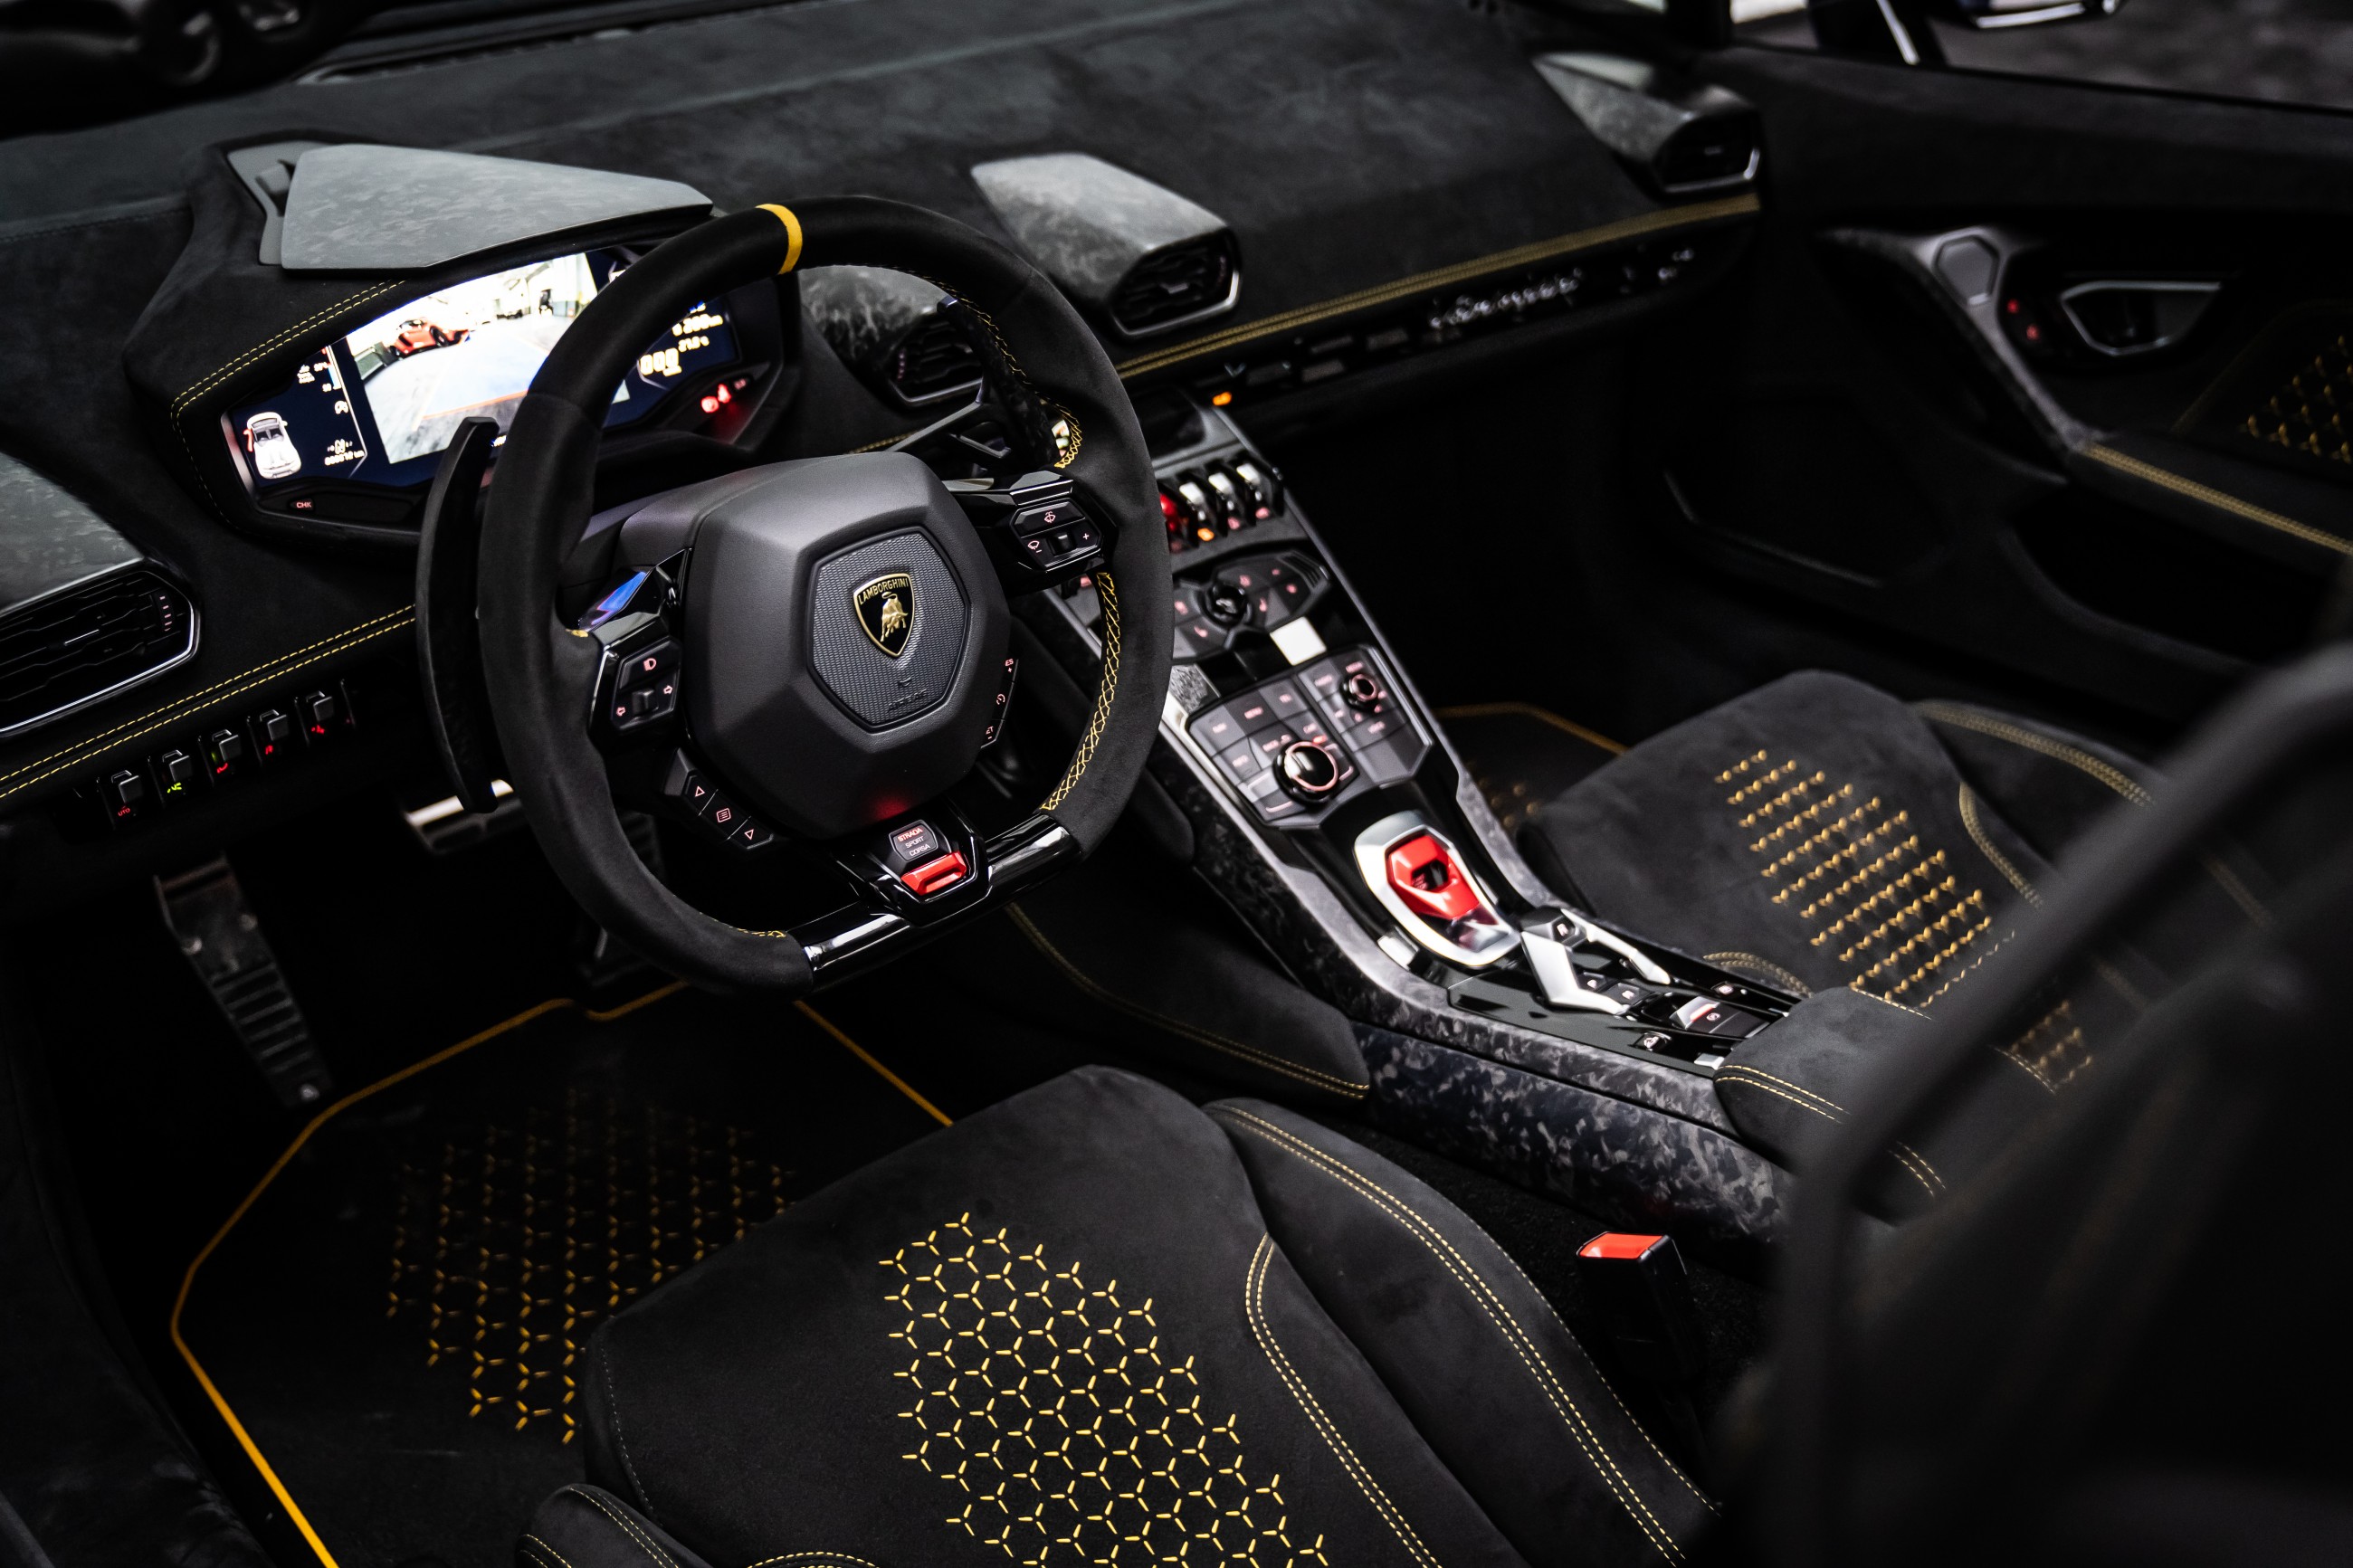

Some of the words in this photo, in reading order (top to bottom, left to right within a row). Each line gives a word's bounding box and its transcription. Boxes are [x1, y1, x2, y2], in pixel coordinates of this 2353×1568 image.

[858, 578, 909, 605] LAMBORGHINI
[898, 828, 923, 841] STRADA
[905, 836, 924, 848] SPORT
[910, 844, 930, 856] CORSA
